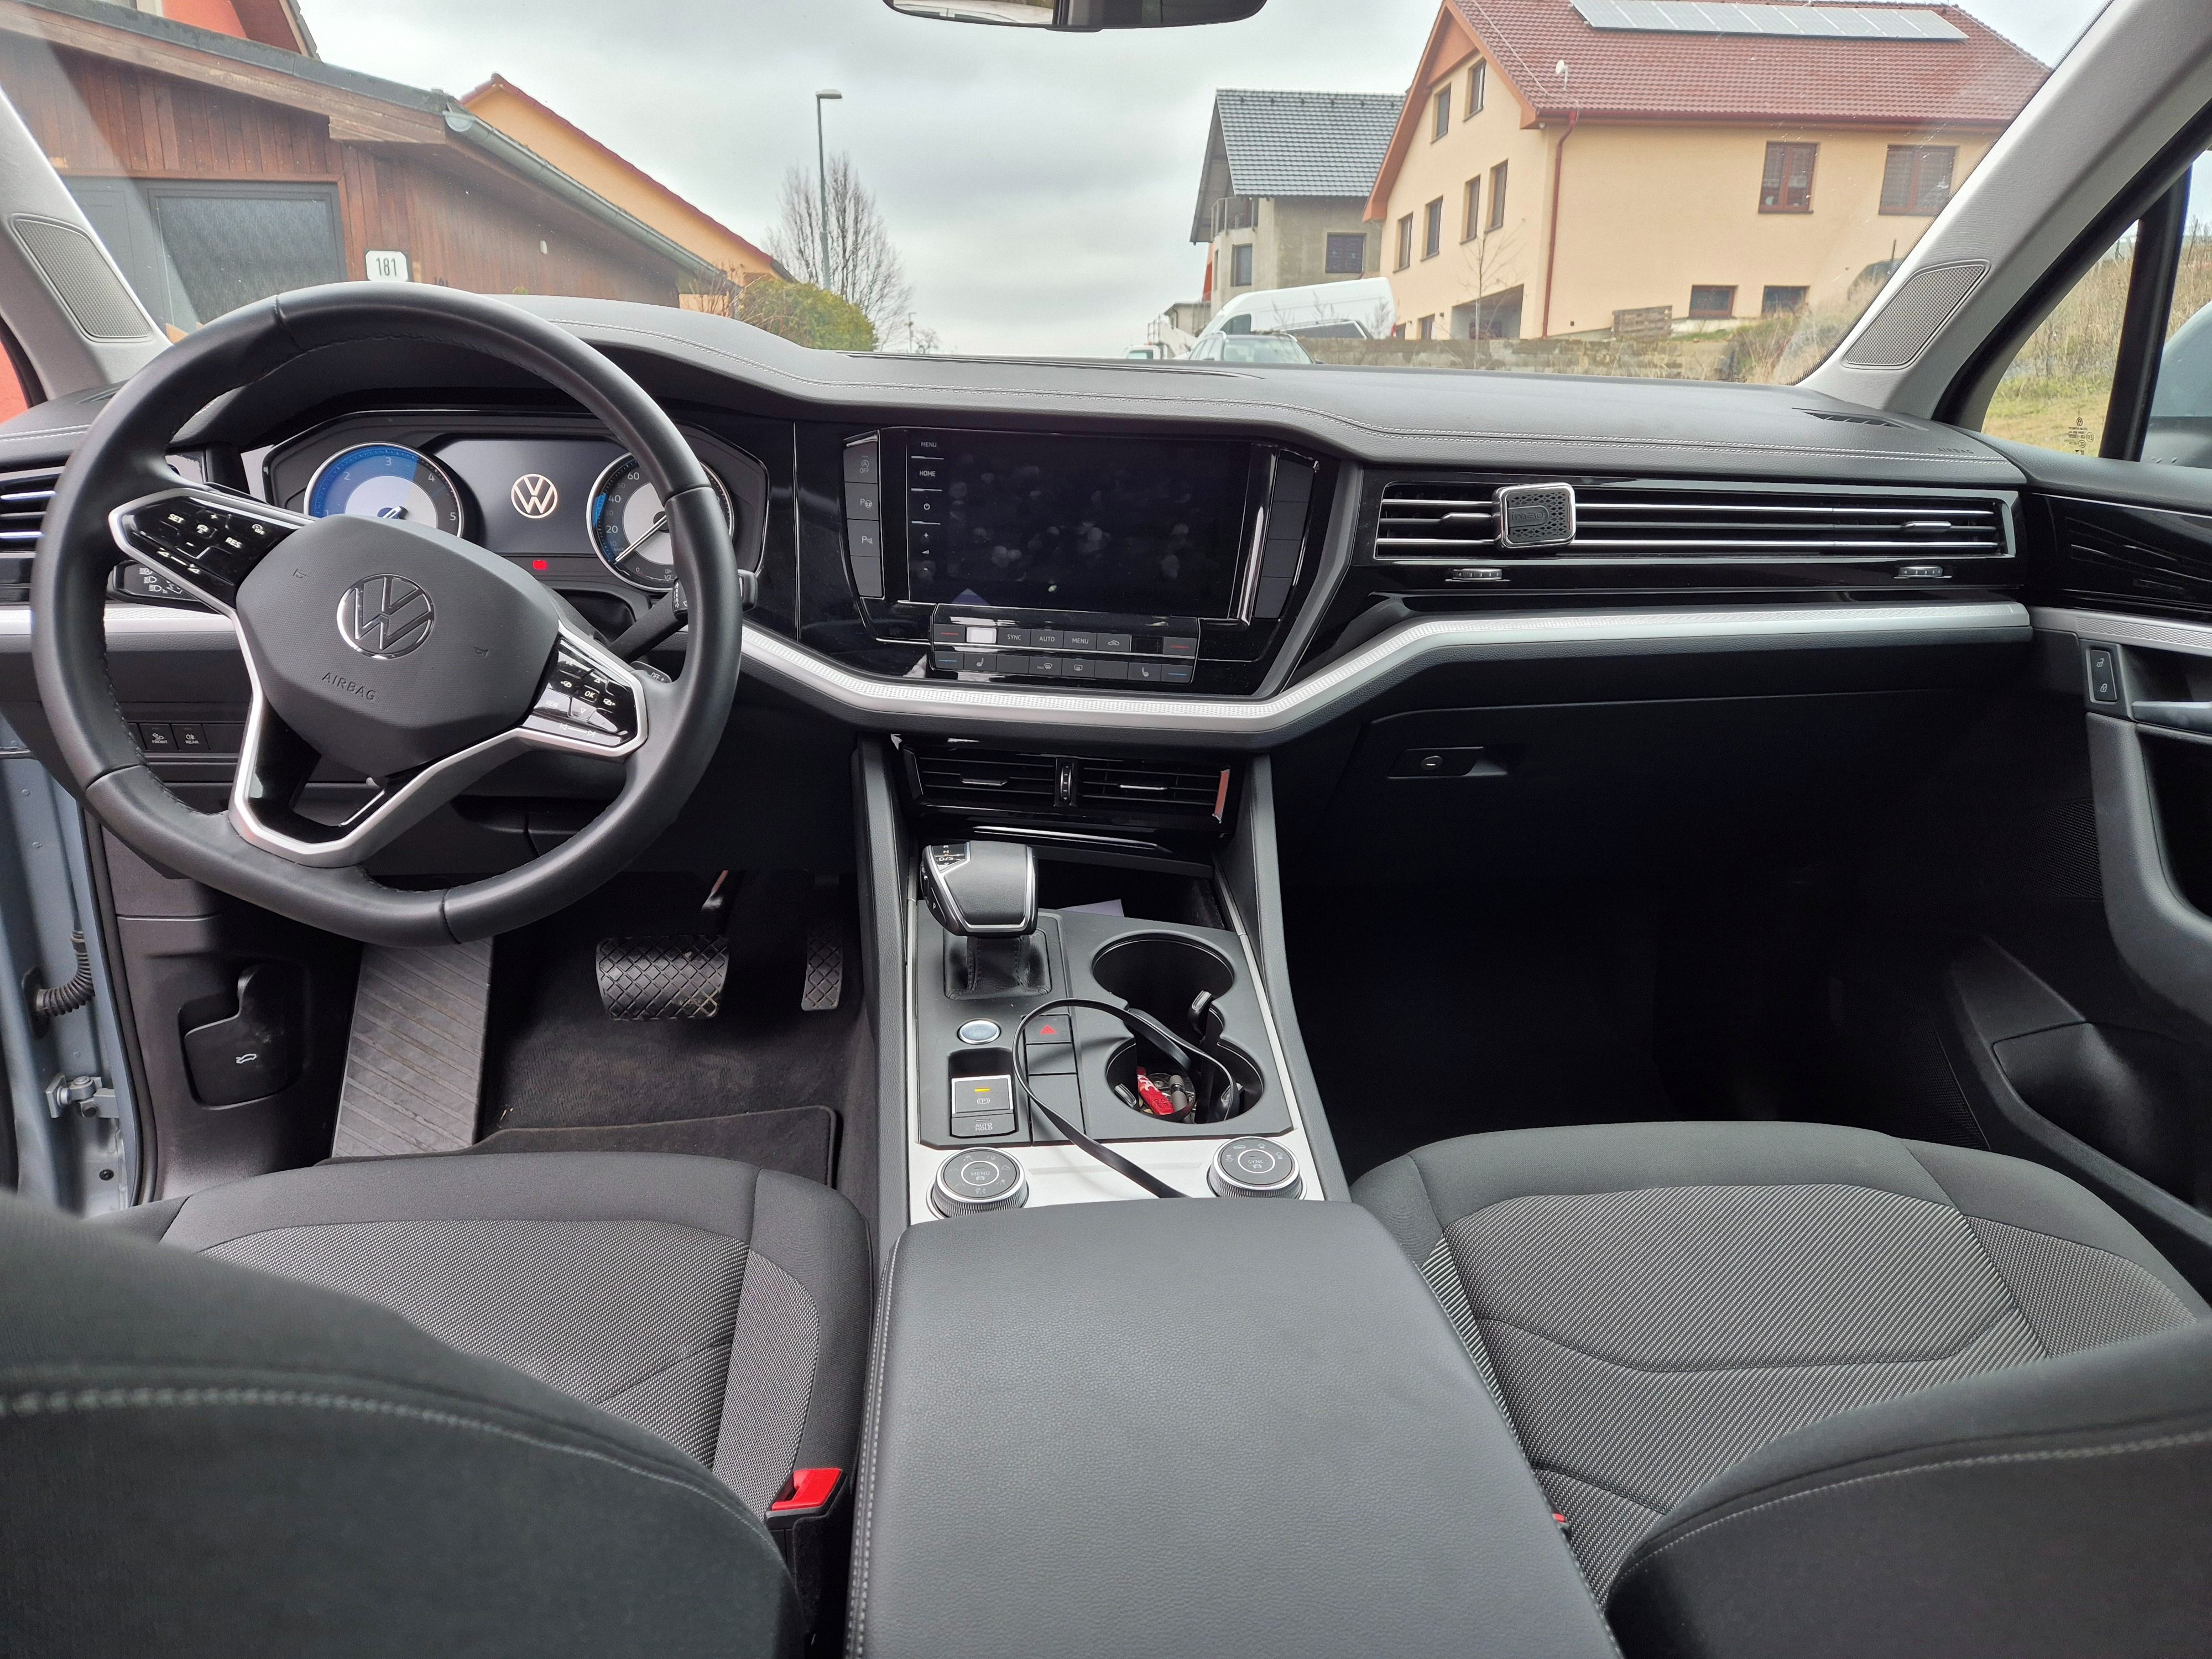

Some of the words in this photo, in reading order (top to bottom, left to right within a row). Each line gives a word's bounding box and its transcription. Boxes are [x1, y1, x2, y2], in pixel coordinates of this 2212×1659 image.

[375, 257, 397, 276] 181
[385, 457, 392, 466] 3
[343, 471, 350, 481] 2
[427, 473, 435, 482] 4
[608, 494, 622, 503] 40
[168, 513, 185, 524] SET
[450, 512, 457, 520] 5
[606, 525, 618, 533] 20
[225, 537, 242, 549] RES
[322, 672, 377, 700] AIRBAG
